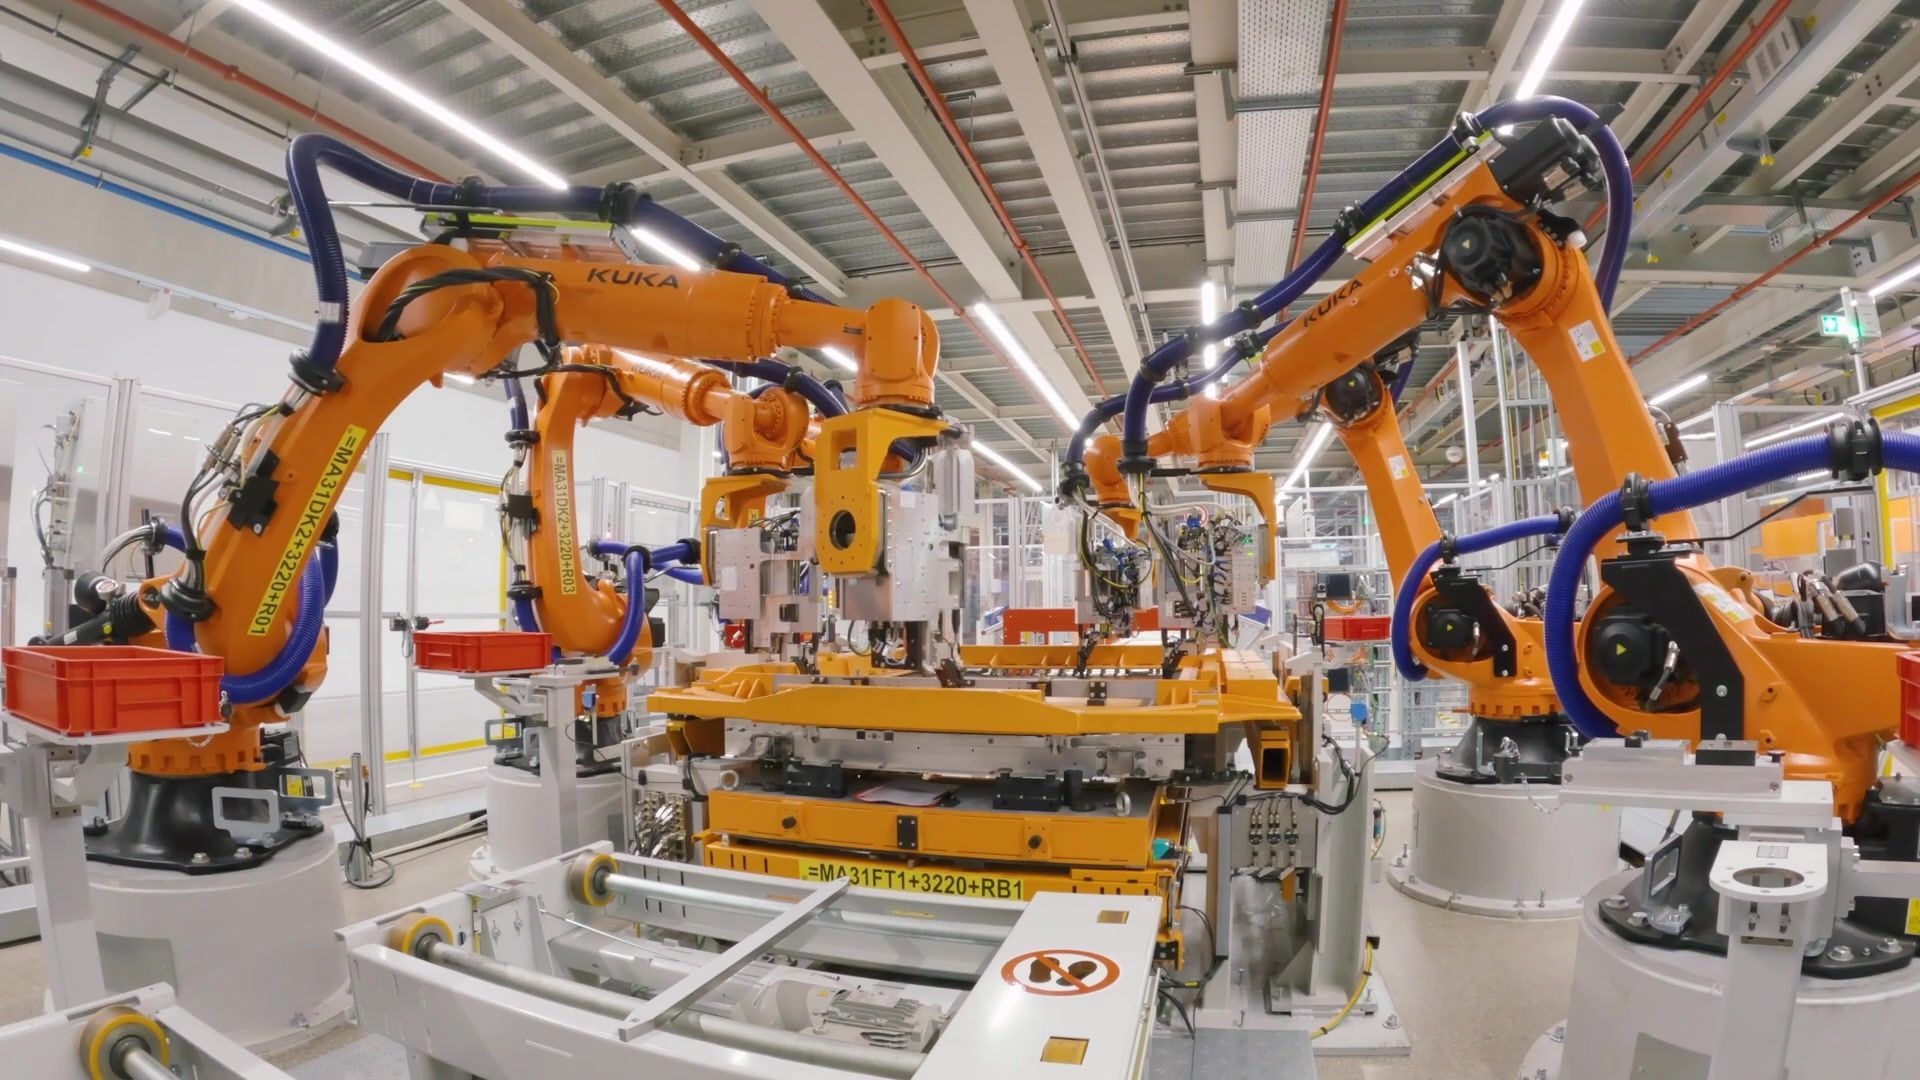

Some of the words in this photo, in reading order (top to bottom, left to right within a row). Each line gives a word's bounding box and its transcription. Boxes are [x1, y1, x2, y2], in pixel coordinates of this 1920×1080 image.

[587, 268, 679, 289] KUKA
[1303, 279, 1363, 328] KUKA
[251, 436, 358, 635] =MA31DK2+3220+R01
[554, 456, 576, 593] =MA31DK2+3220+R03
[808, 863, 1023, 900] =MA31FT1+3220+RB1
